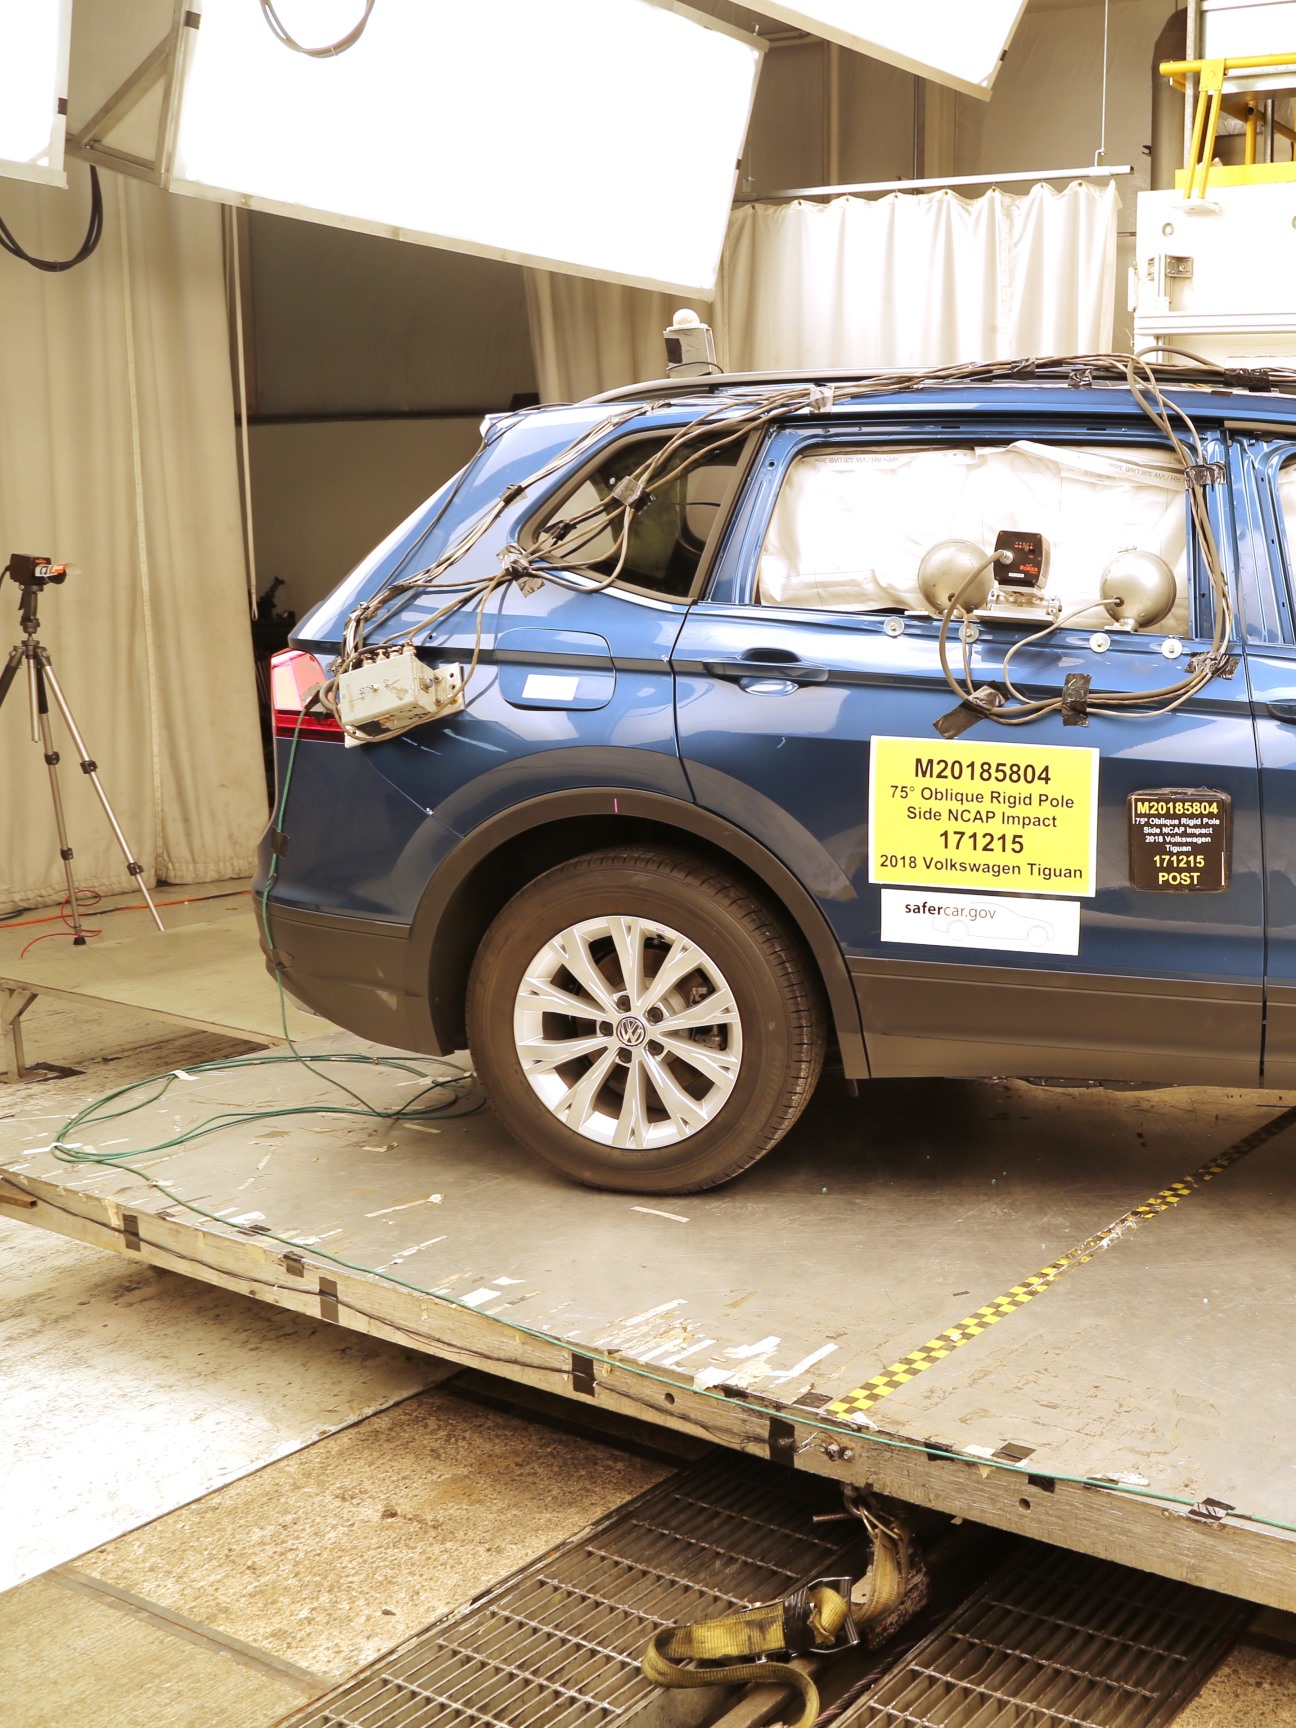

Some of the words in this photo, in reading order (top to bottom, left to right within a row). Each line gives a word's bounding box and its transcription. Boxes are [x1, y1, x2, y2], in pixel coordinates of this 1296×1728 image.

[914, 758, 1051, 785] M20185804
[921, 787, 984, 805] Oblique
[990, 791, 1032, 808] Rigid
[1038, 794, 1075, 808] Pole
[1136, 802, 1218, 814] M20185804
[907, 806, 942, 821] Side
[948, 809, 996, 824] NCAP
[1001, 812, 1057, 829] Impact
[1149, 818, 1179, 826] Oblique
[1181, 818, 1202, 826] Rigid
[1186, 827, 1213, 835] Impact
[939, 830, 1024, 854] 171215
[1145, 835, 1163, 843] 2018
[1165, 835, 1211, 844] Volkswagen
[1165, 844, 1192, 853] Tiguan
[880, 854, 917, 869] 2018
[922, 856, 1021, 877] Volkswagen
[1027, 863, 1083, 880] Tiguan
[1153, 855, 1205, 867] 171215
[1158, 872, 1200, 885] POST
[905, 901, 997, 922] safercar.gov
